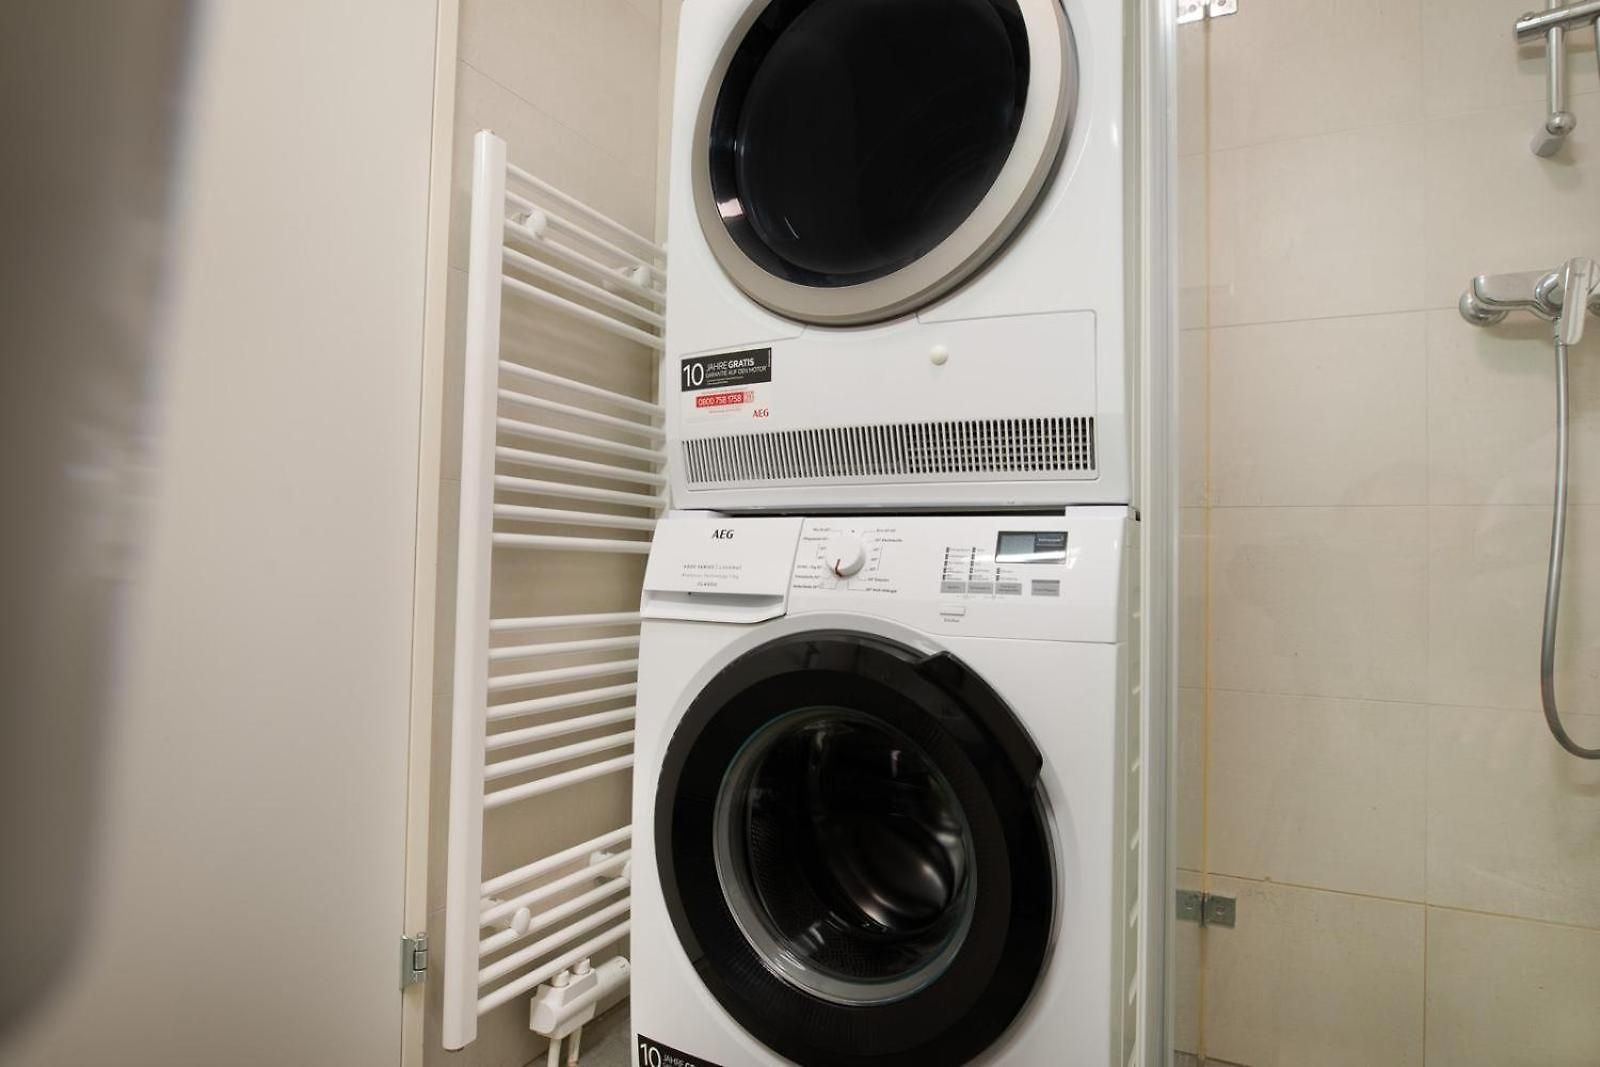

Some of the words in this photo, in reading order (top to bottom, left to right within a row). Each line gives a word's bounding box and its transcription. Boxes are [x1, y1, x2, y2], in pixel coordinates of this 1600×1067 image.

[683, 363, 704, 387] 10
[706, 360, 728, 371] JAHRE
[728, 357, 755, 369] GRATIS
[749, 365, 767, 373] MOTOR
[753, 408, 769, 418] AEG
[712, 529, 734, 539] AEG
[640, 1043, 662, 1067] 10
